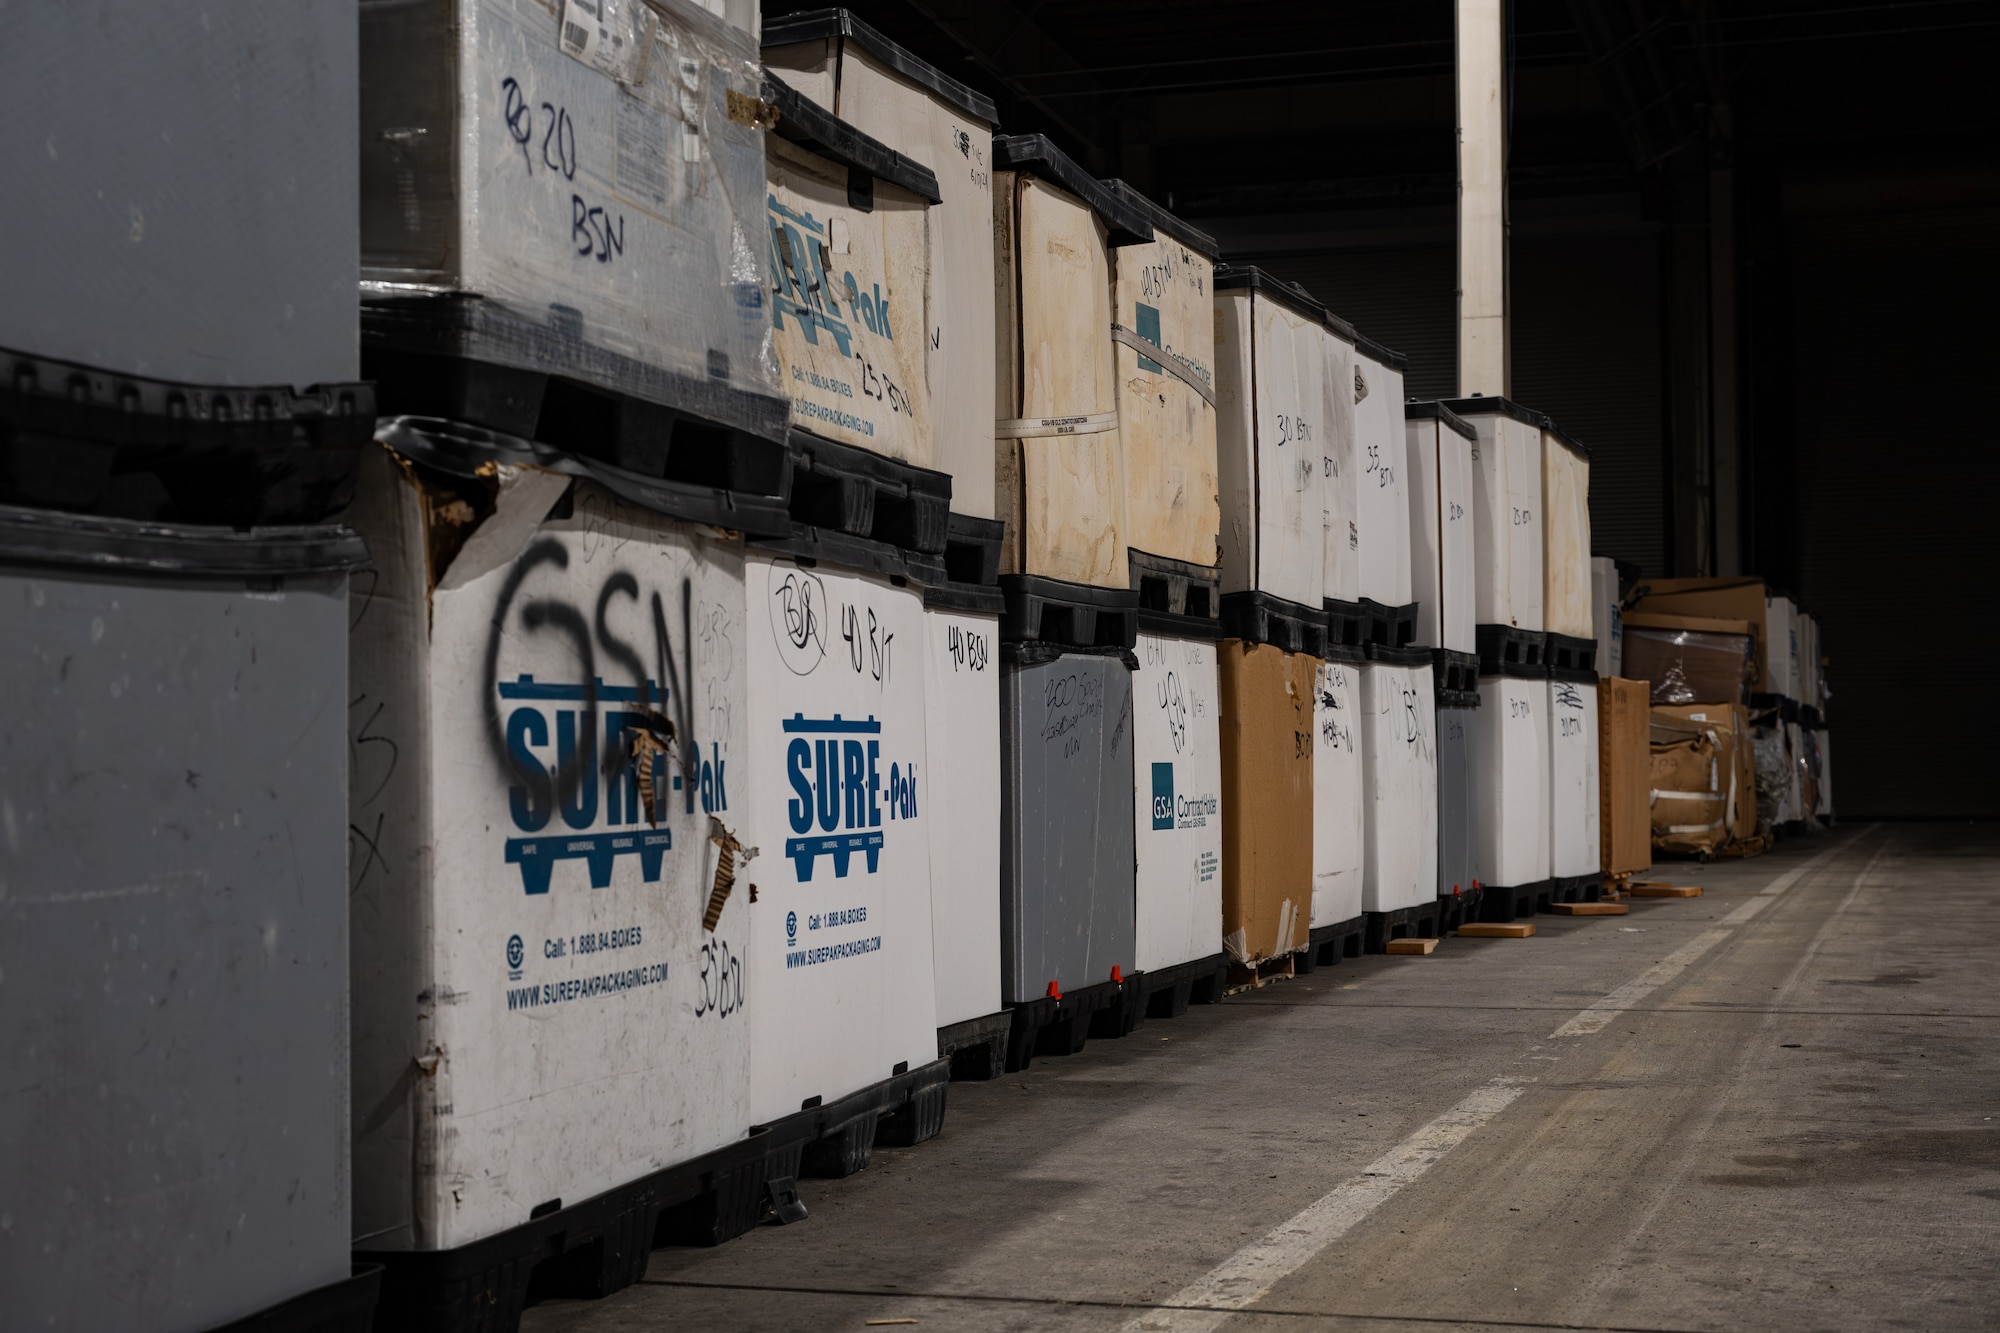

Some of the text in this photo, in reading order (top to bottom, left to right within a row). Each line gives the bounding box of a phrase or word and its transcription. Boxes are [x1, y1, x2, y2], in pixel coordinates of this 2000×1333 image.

[572, 194, 624, 263] BSN
[1277, 414, 1293, 447] 30
[1366, 445, 1380, 473] 35
[1153, 795, 1174, 820] GSA
[808, 906, 867, 931] Call: 1.888.84.BOXES
[543, 926, 643, 960] Call: 1.888.84.BOXES
[785, 935, 882, 969] WWW.SUREPAKPACKAGING.COM
[506, 962, 669, 1011] WWW.SUREPAKPACKAGING.COM
